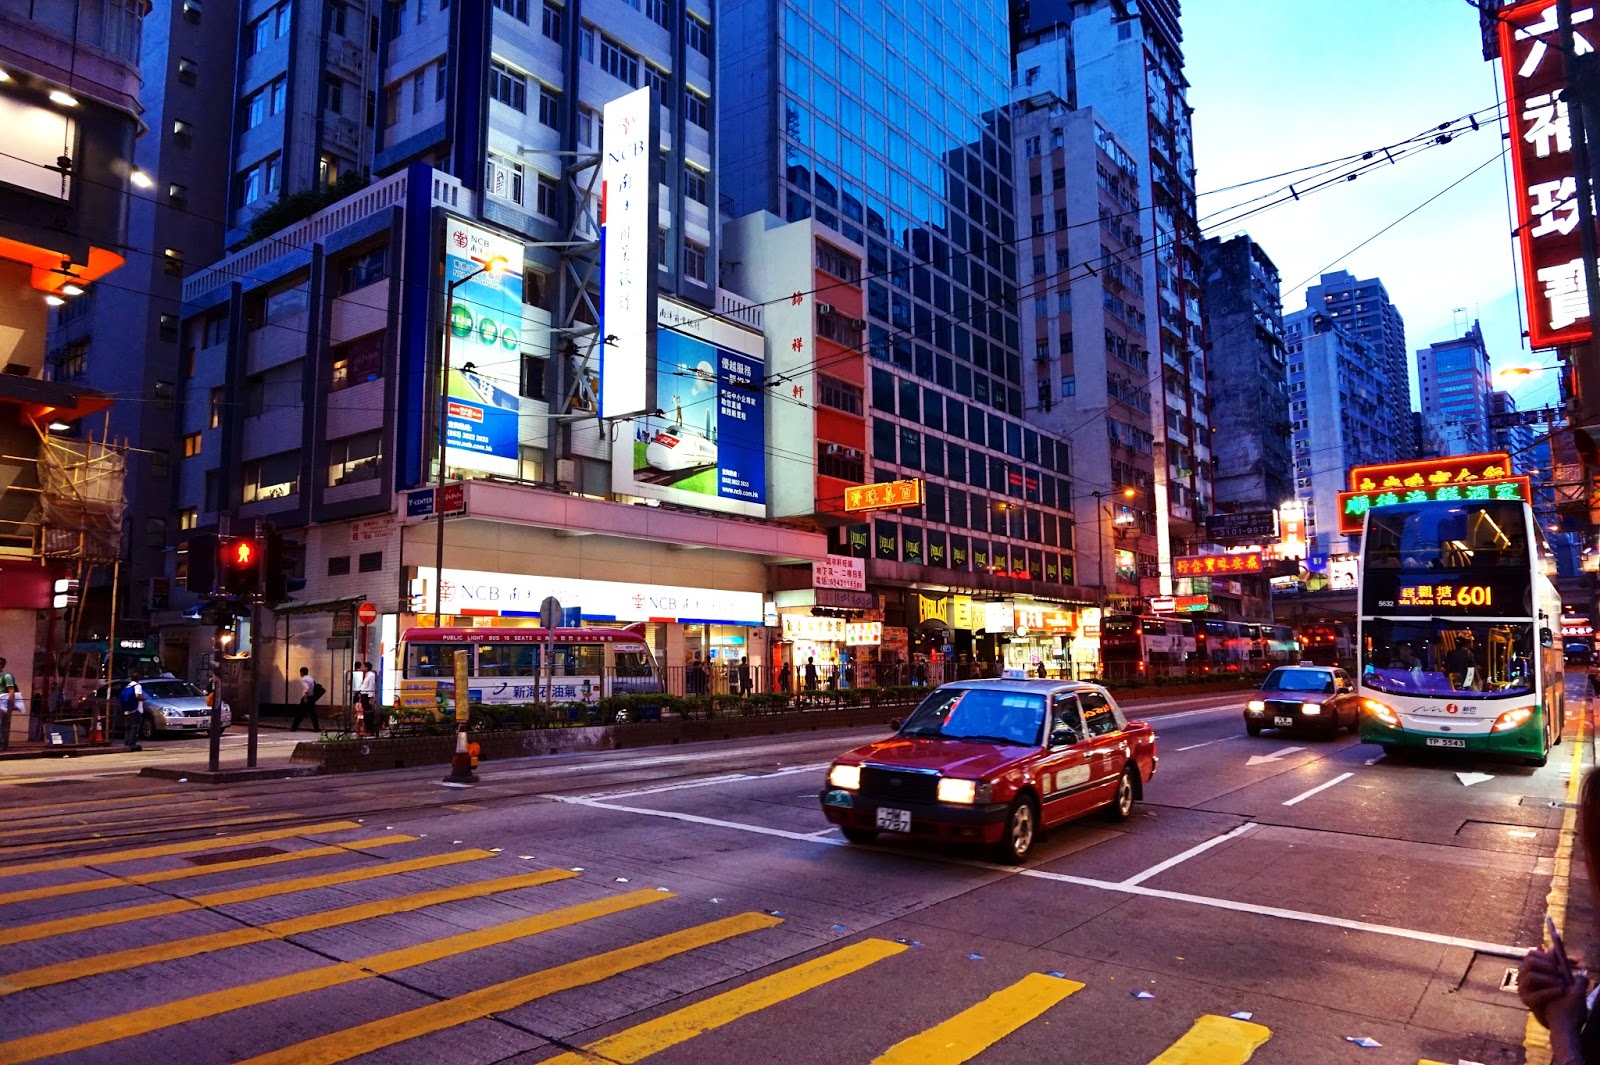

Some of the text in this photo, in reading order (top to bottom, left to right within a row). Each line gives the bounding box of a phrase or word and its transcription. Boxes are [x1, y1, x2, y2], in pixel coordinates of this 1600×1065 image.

[609, 141, 644, 167] NCB
[470, 235, 490, 248] NCB
[721, 357, 752, 378] 優越服務
[721, 487, 759, 498] www.ncb.com.hk
[1220, 526, 1271, 536] 3101-9977
[462, 585, 500, 601] NCB
[1401, 585, 1453, 598] 經觀塘
[1457, 586, 1492, 606] 601
[649, 596, 677, 610] NCB
[1412, 597, 1434, 605] Kwun
[1436, 597, 1457, 606] Tong
[918, 593, 948, 626] EVERLAST
[1442, 739, 1464, 747] 5543
